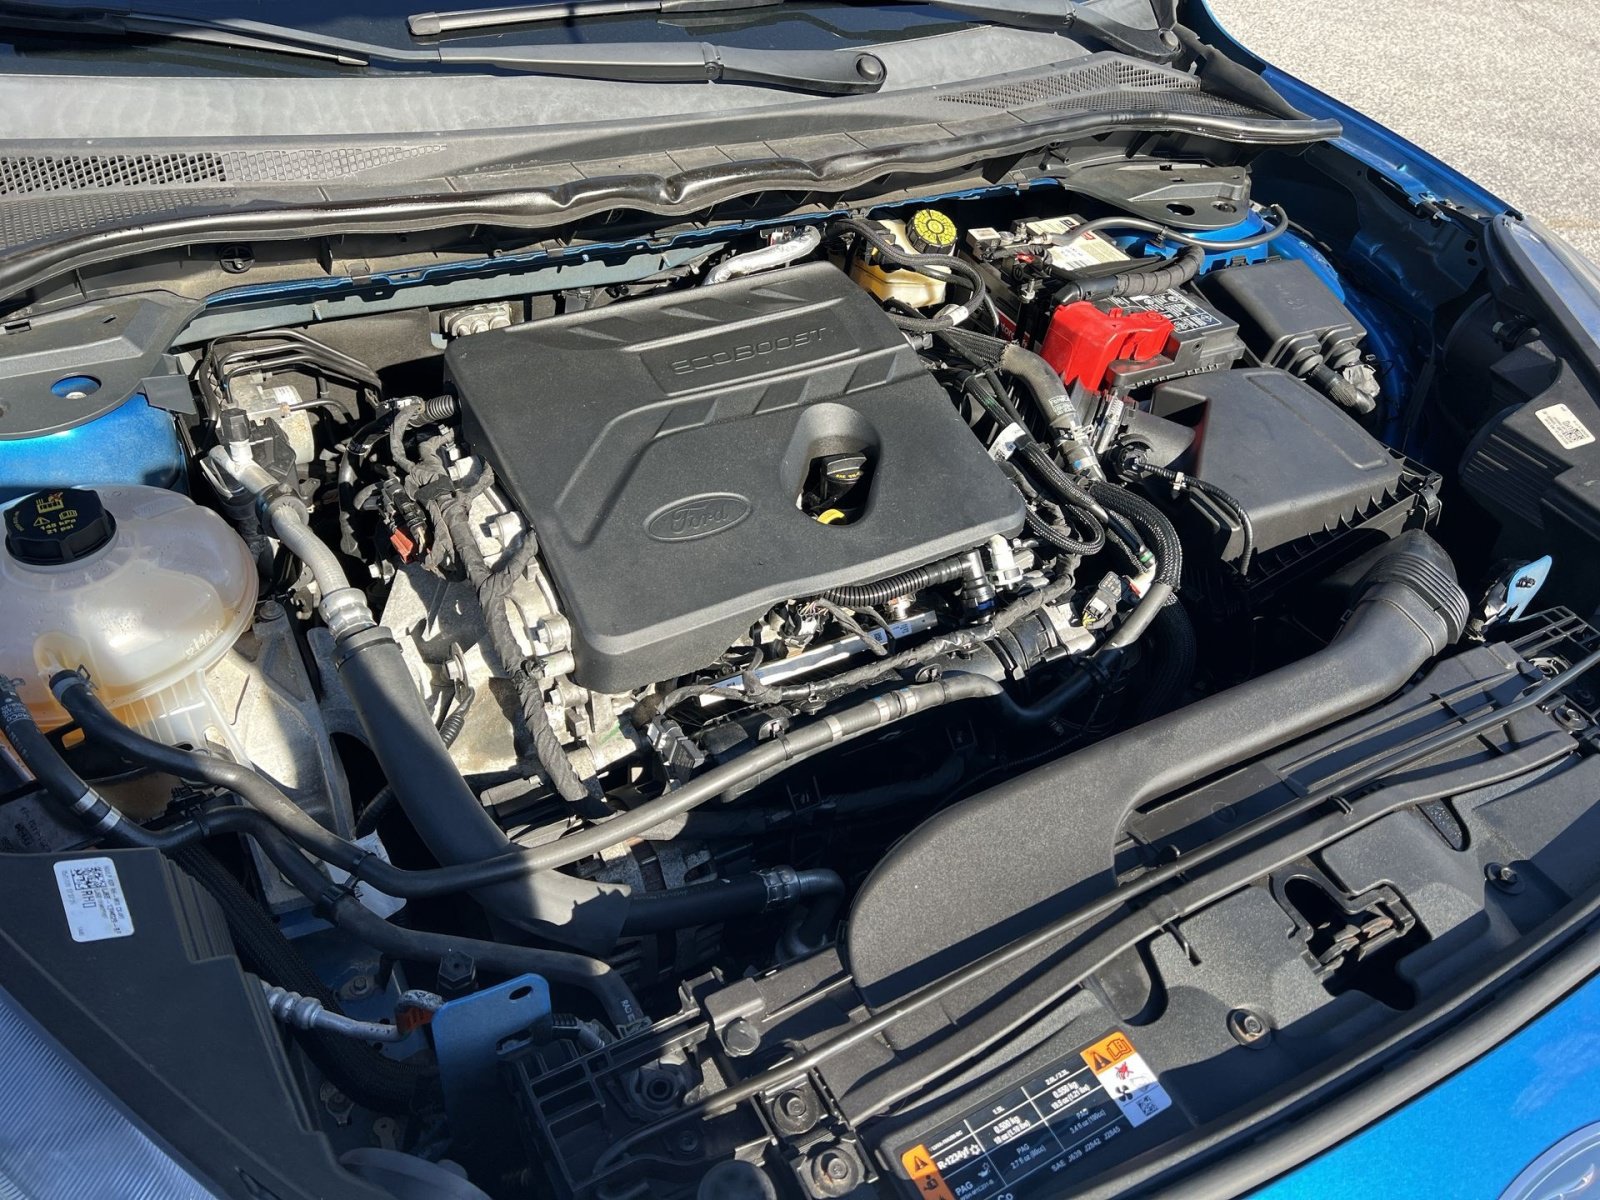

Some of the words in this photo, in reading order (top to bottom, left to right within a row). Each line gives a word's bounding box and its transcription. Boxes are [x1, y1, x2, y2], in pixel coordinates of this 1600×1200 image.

[671, 327, 826, 375] ECOBOOST
[670, 503, 729, 535] Ford
[1052, 1084, 1071, 1099] 0.550
[1067, 1081, 1079, 1091] kg
[1076, 1108, 1089, 1120] PAG
[993, 1119, 1012, 1134] 0.500
[1008, 1115, 1021, 1125] kg
[1016, 1143, 1030, 1155] PAG
[1051, 1160, 1066, 1172] SAE
[955, 1181, 974, 1196] PAG
